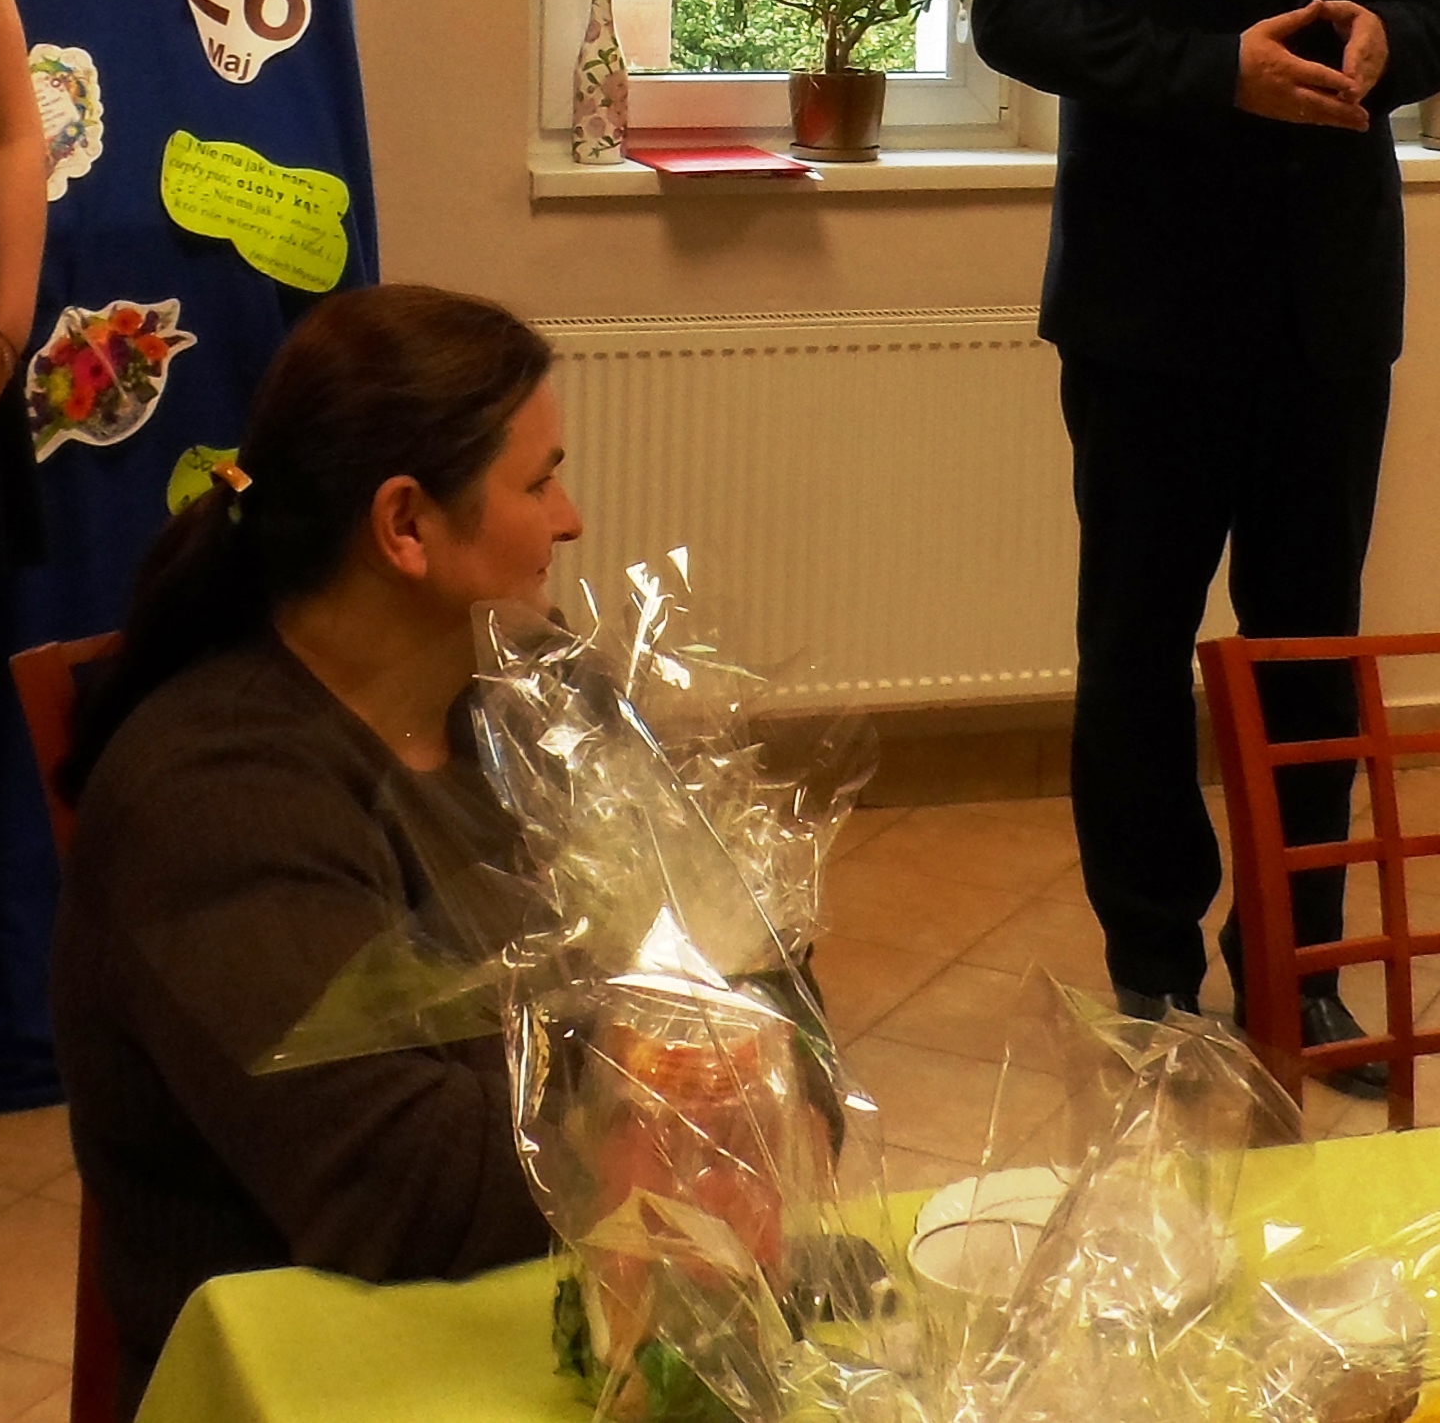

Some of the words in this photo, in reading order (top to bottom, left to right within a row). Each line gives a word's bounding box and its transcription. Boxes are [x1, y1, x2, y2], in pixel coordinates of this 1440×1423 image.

[208, 37, 252, 81] Maj
[194, 142, 218, 159] Nie
[221, 153, 243, 168] ma
[244, 158, 265, 172] jak
[236, 179, 284, 203] cichy
